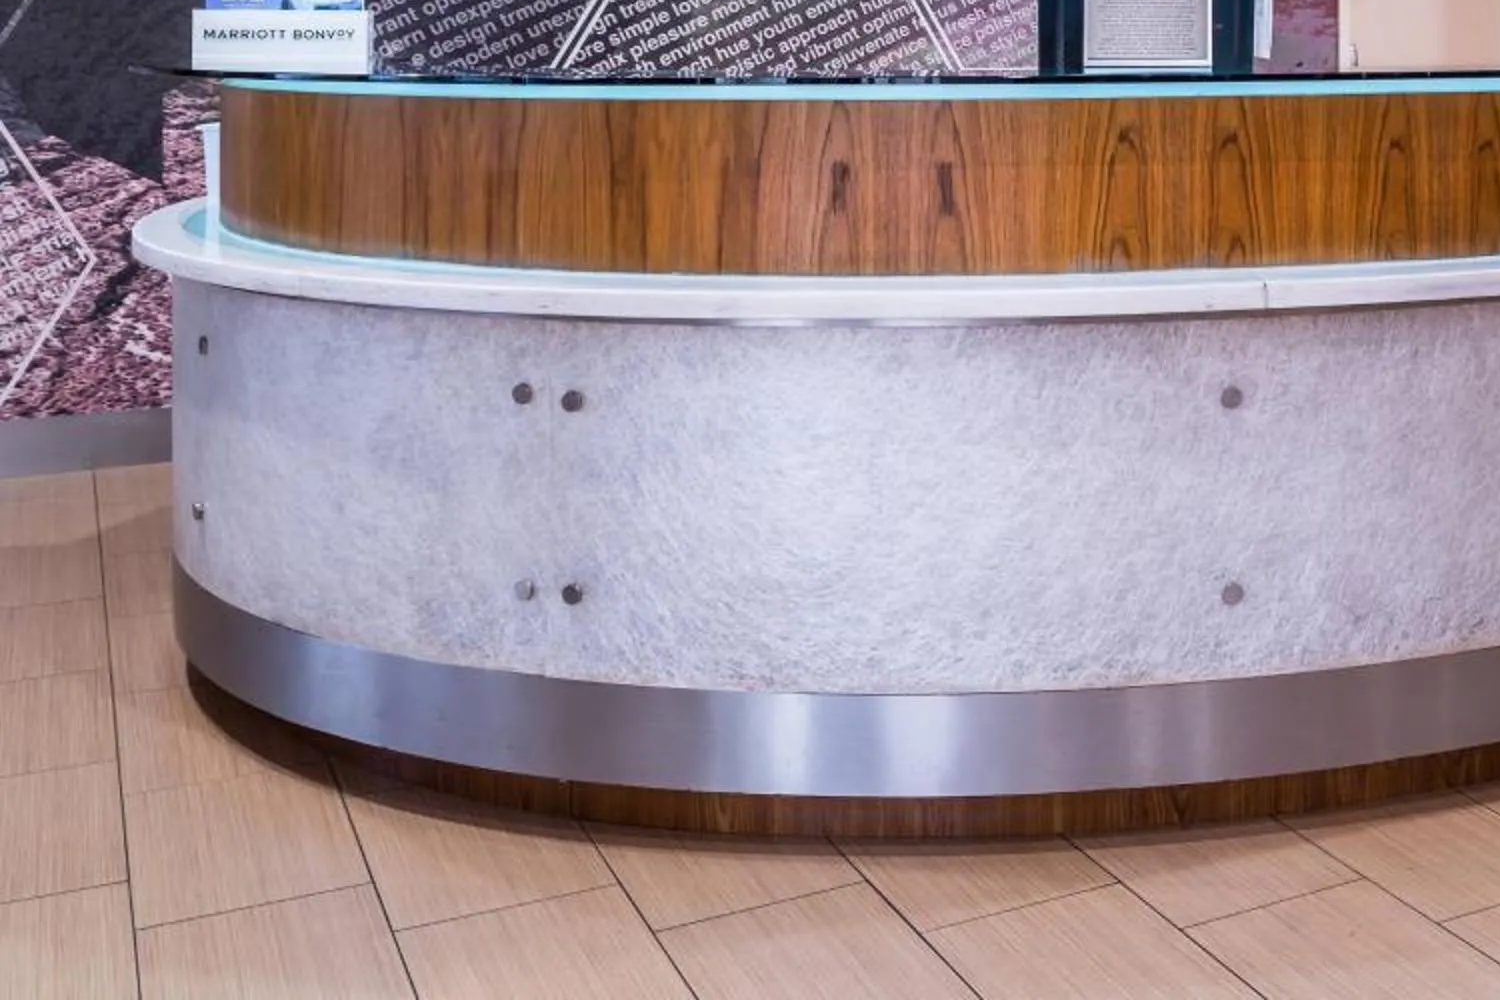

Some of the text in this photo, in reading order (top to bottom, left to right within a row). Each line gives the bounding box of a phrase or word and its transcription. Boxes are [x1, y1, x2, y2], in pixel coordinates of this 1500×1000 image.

[203, 29, 356, 41] MARRIOTT BONVOY
[429, 22, 497, 58] design
[609, 11, 670, 46] simple
[630, 16, 708, 65] pleasure
[660, 6, 770, 66] environment
[715, 39, 749, 61] hue
[753, 14, 803, 45] youth
[779, 9, 858, 53] approach
[800, 27, 860, 62] vibrant
[506, 44, 549, 69] love
